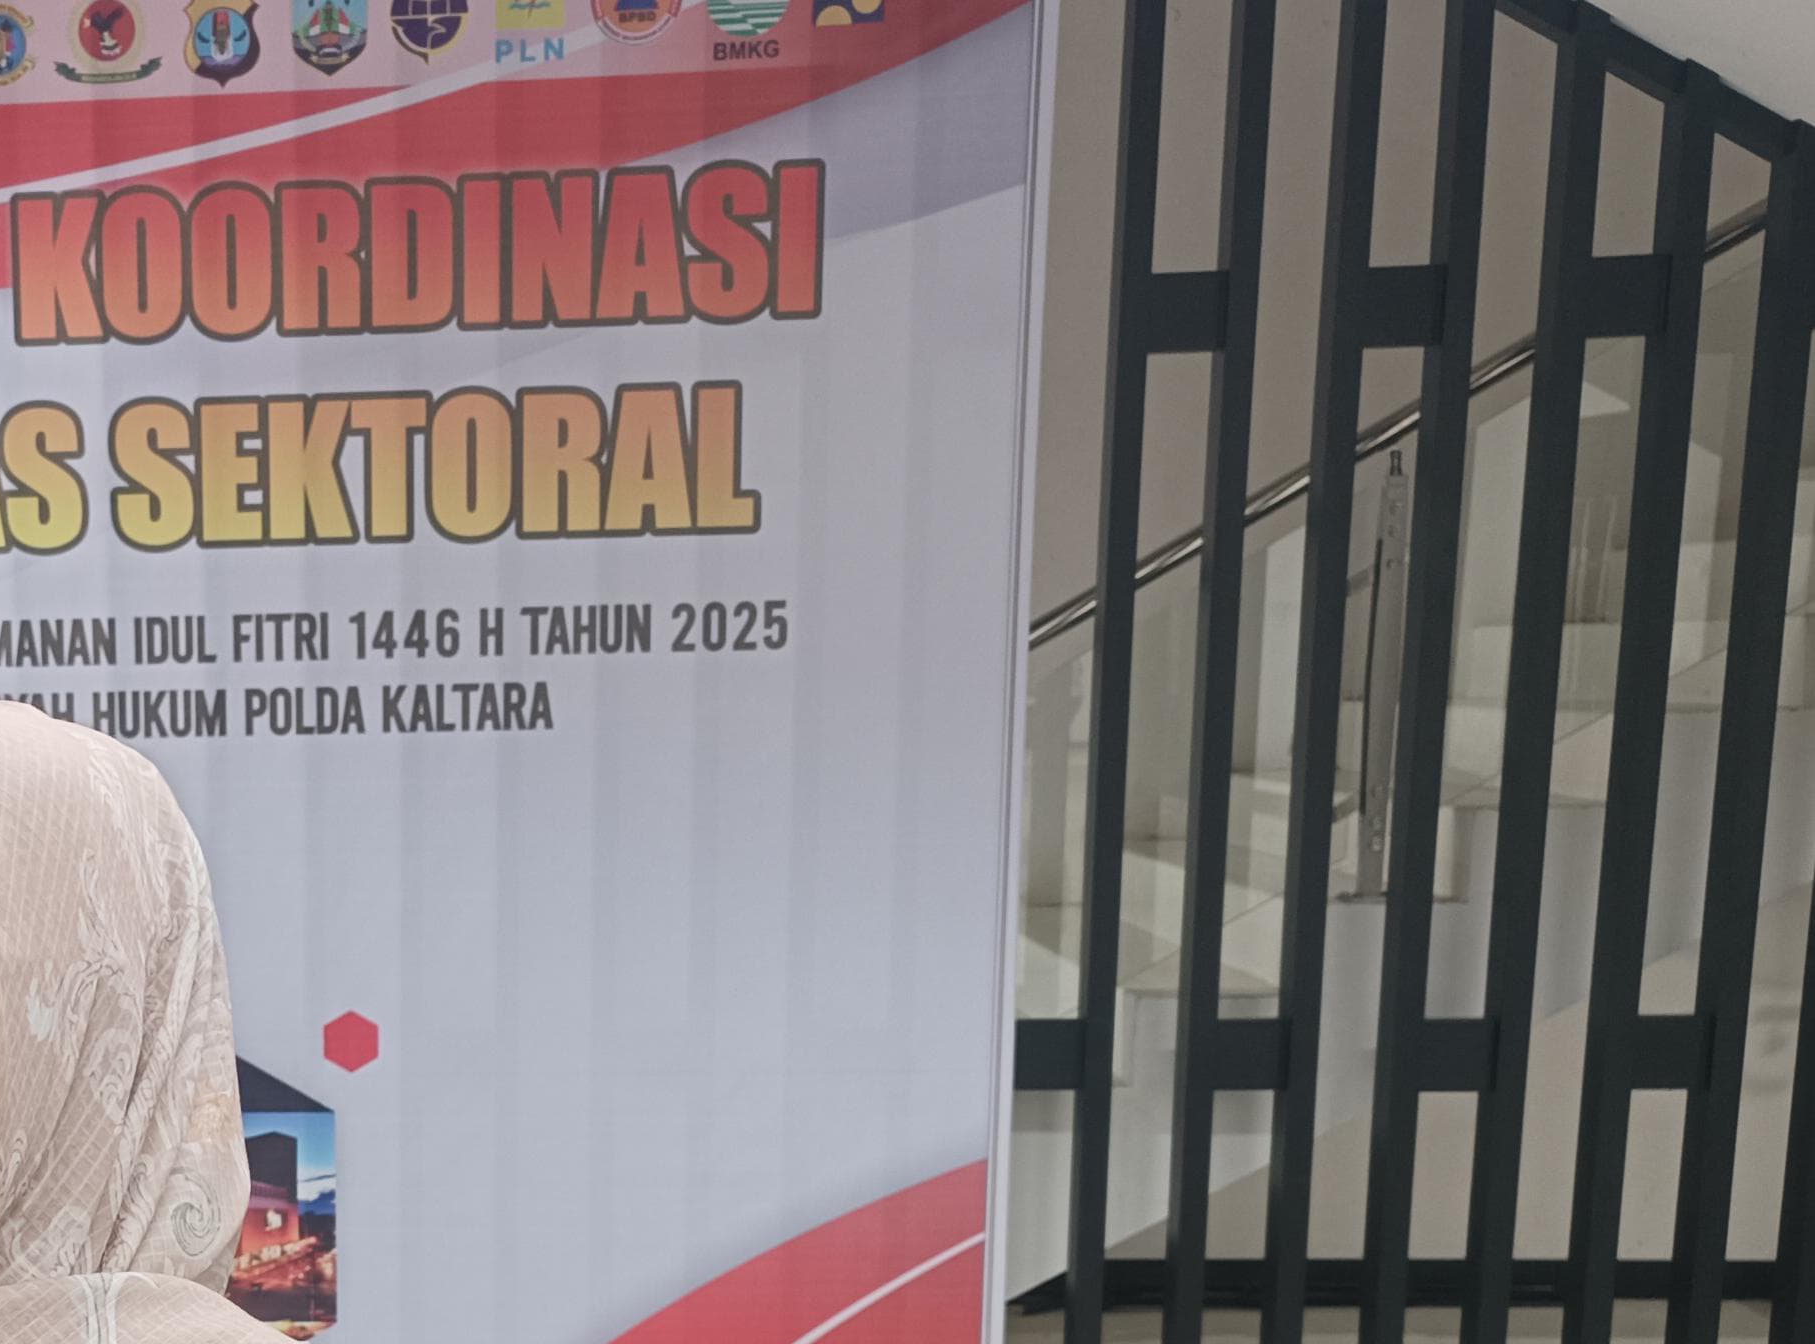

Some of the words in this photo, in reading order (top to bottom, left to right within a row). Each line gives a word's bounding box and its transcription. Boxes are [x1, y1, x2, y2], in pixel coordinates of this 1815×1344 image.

[494, 37, 566, 64] PLN
[712, 40, 781, 61] BMKG
[11, 159, 825, 346] KOORDINASI
[107, 380, 762, 553] SEKTORAL
[133, 614, 216, 665] IDUL
[232, 612, 329, 662] FITRI
[348, 608, 460, 660] 1446
[479, 607, 504, 656] H
[520, 604, 652, 655] TAHUN
[671, 600, 788, 653] 2025
[92, 689, 227, 738] HUKUM
[245, 686, 366, 735] POLDA
[382, 681, 554, 733] KALTARA
